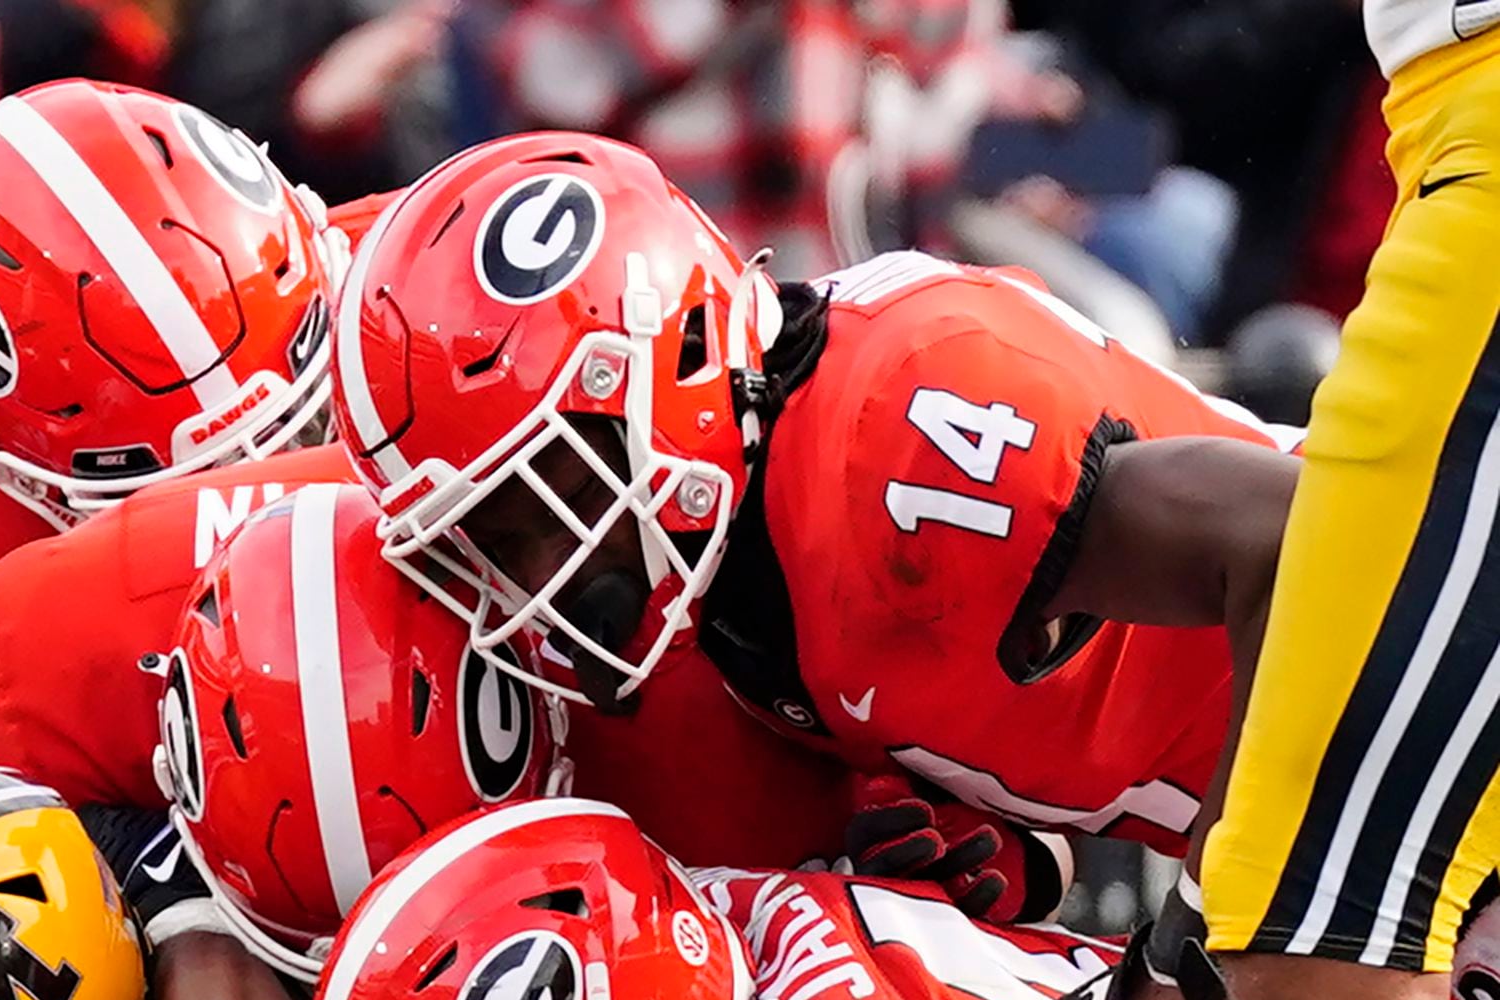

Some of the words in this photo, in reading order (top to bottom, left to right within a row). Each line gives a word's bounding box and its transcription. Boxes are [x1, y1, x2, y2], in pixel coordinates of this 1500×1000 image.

[474, 174, 606, 305] G
[96, 453, 128, 466] NIKE
[189, 383, 270, 445] DAWGS
[884, 385, 1038, 539] 14
[458, 638, 534, 801] G
